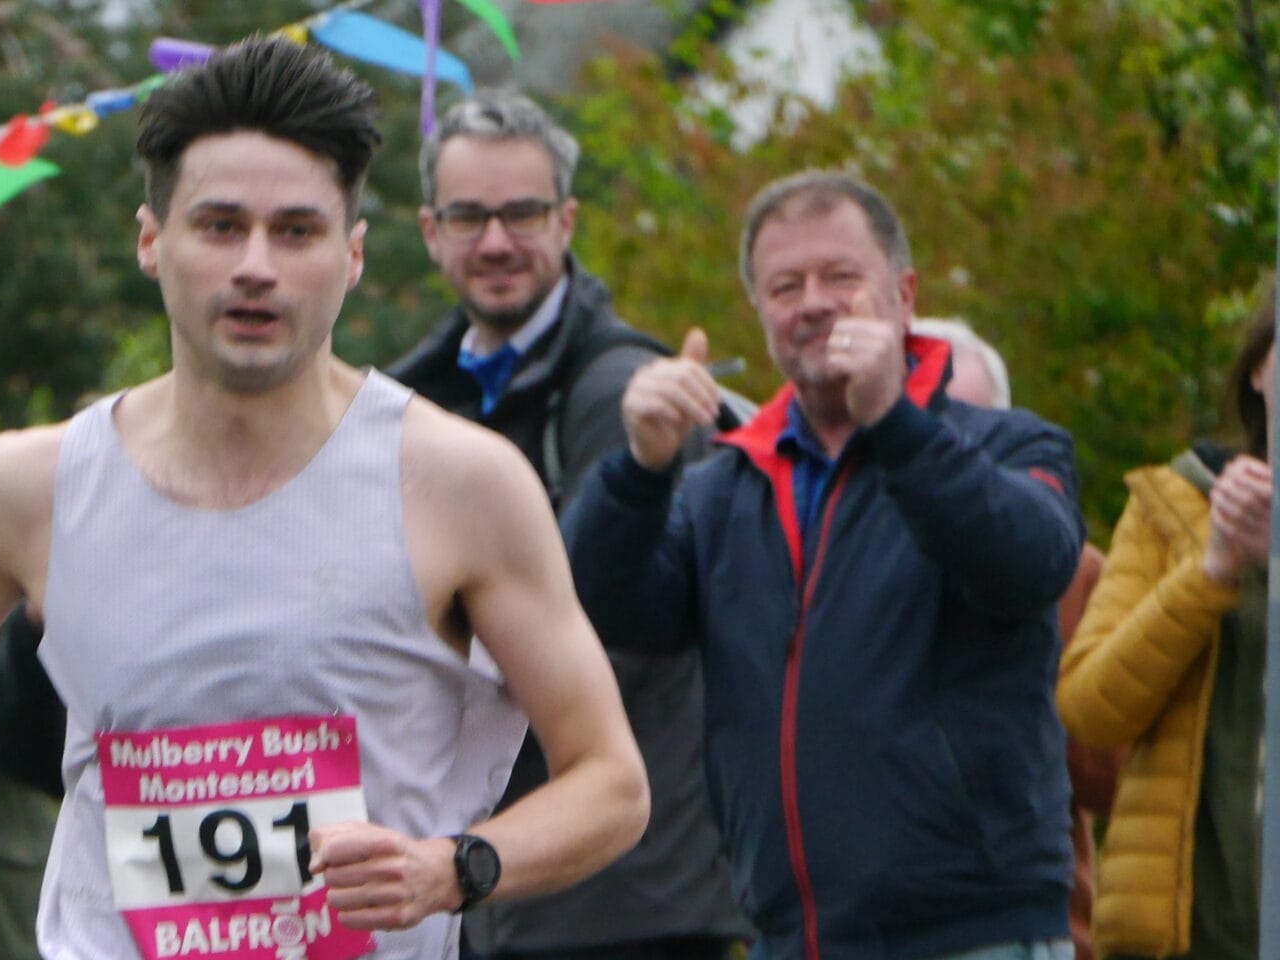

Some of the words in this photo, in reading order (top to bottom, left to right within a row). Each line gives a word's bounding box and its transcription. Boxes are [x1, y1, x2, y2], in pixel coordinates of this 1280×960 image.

[111, 735, 253, 768] Mulberry
[262, 722, 340, 757] Bush
[139, 758, 316, 803] Montessori
[142, 799, 314, 895] 191
[155, 904, 331, 958] BALFRON
